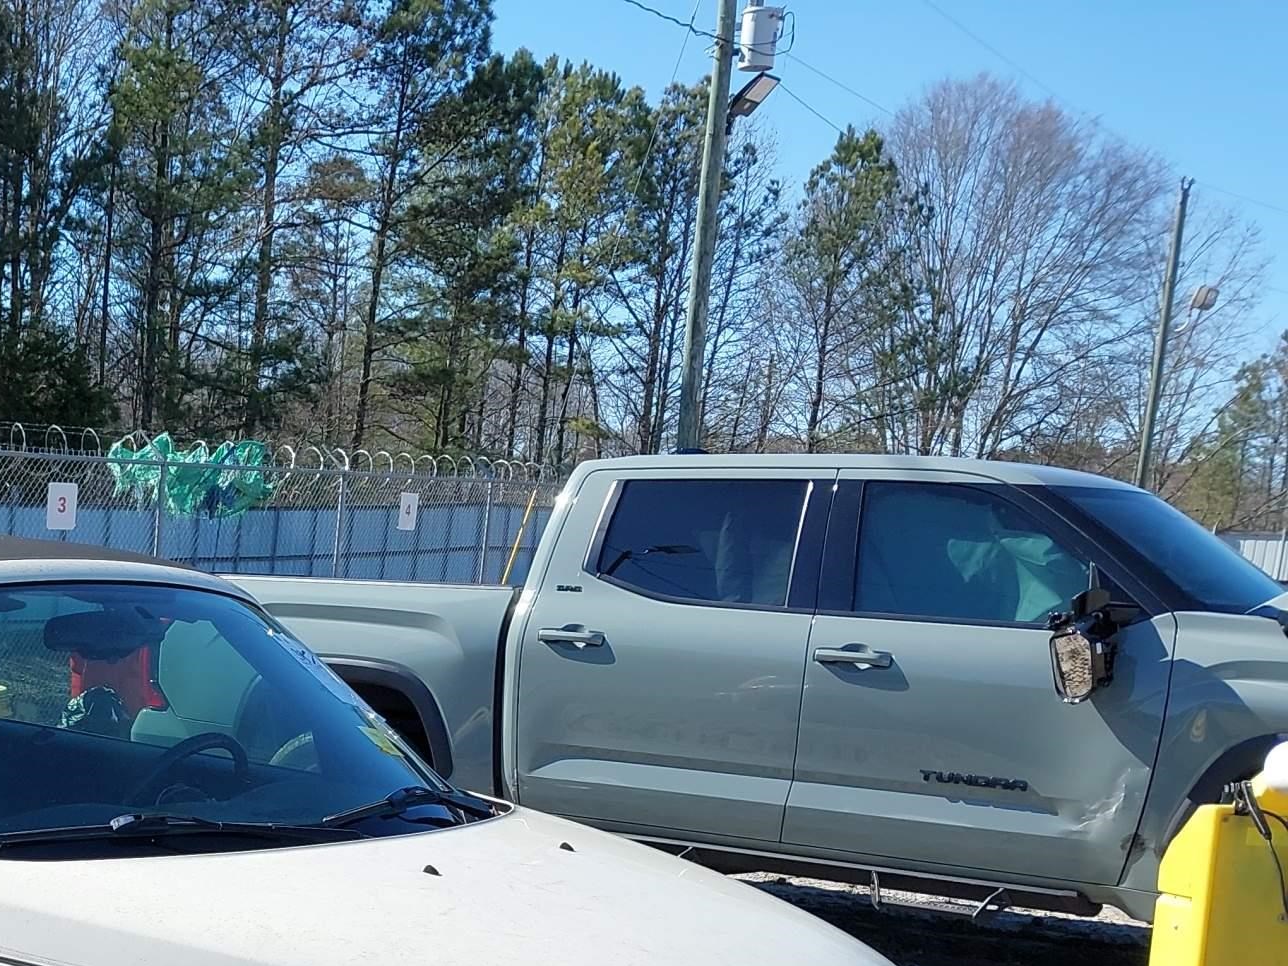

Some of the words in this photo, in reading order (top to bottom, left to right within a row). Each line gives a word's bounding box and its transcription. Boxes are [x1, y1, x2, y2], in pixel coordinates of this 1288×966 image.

[57, 496, 67, 513] 3
[405, 503, 411, 517] 4
[919, 769, 1029, 792] TUNDRA
